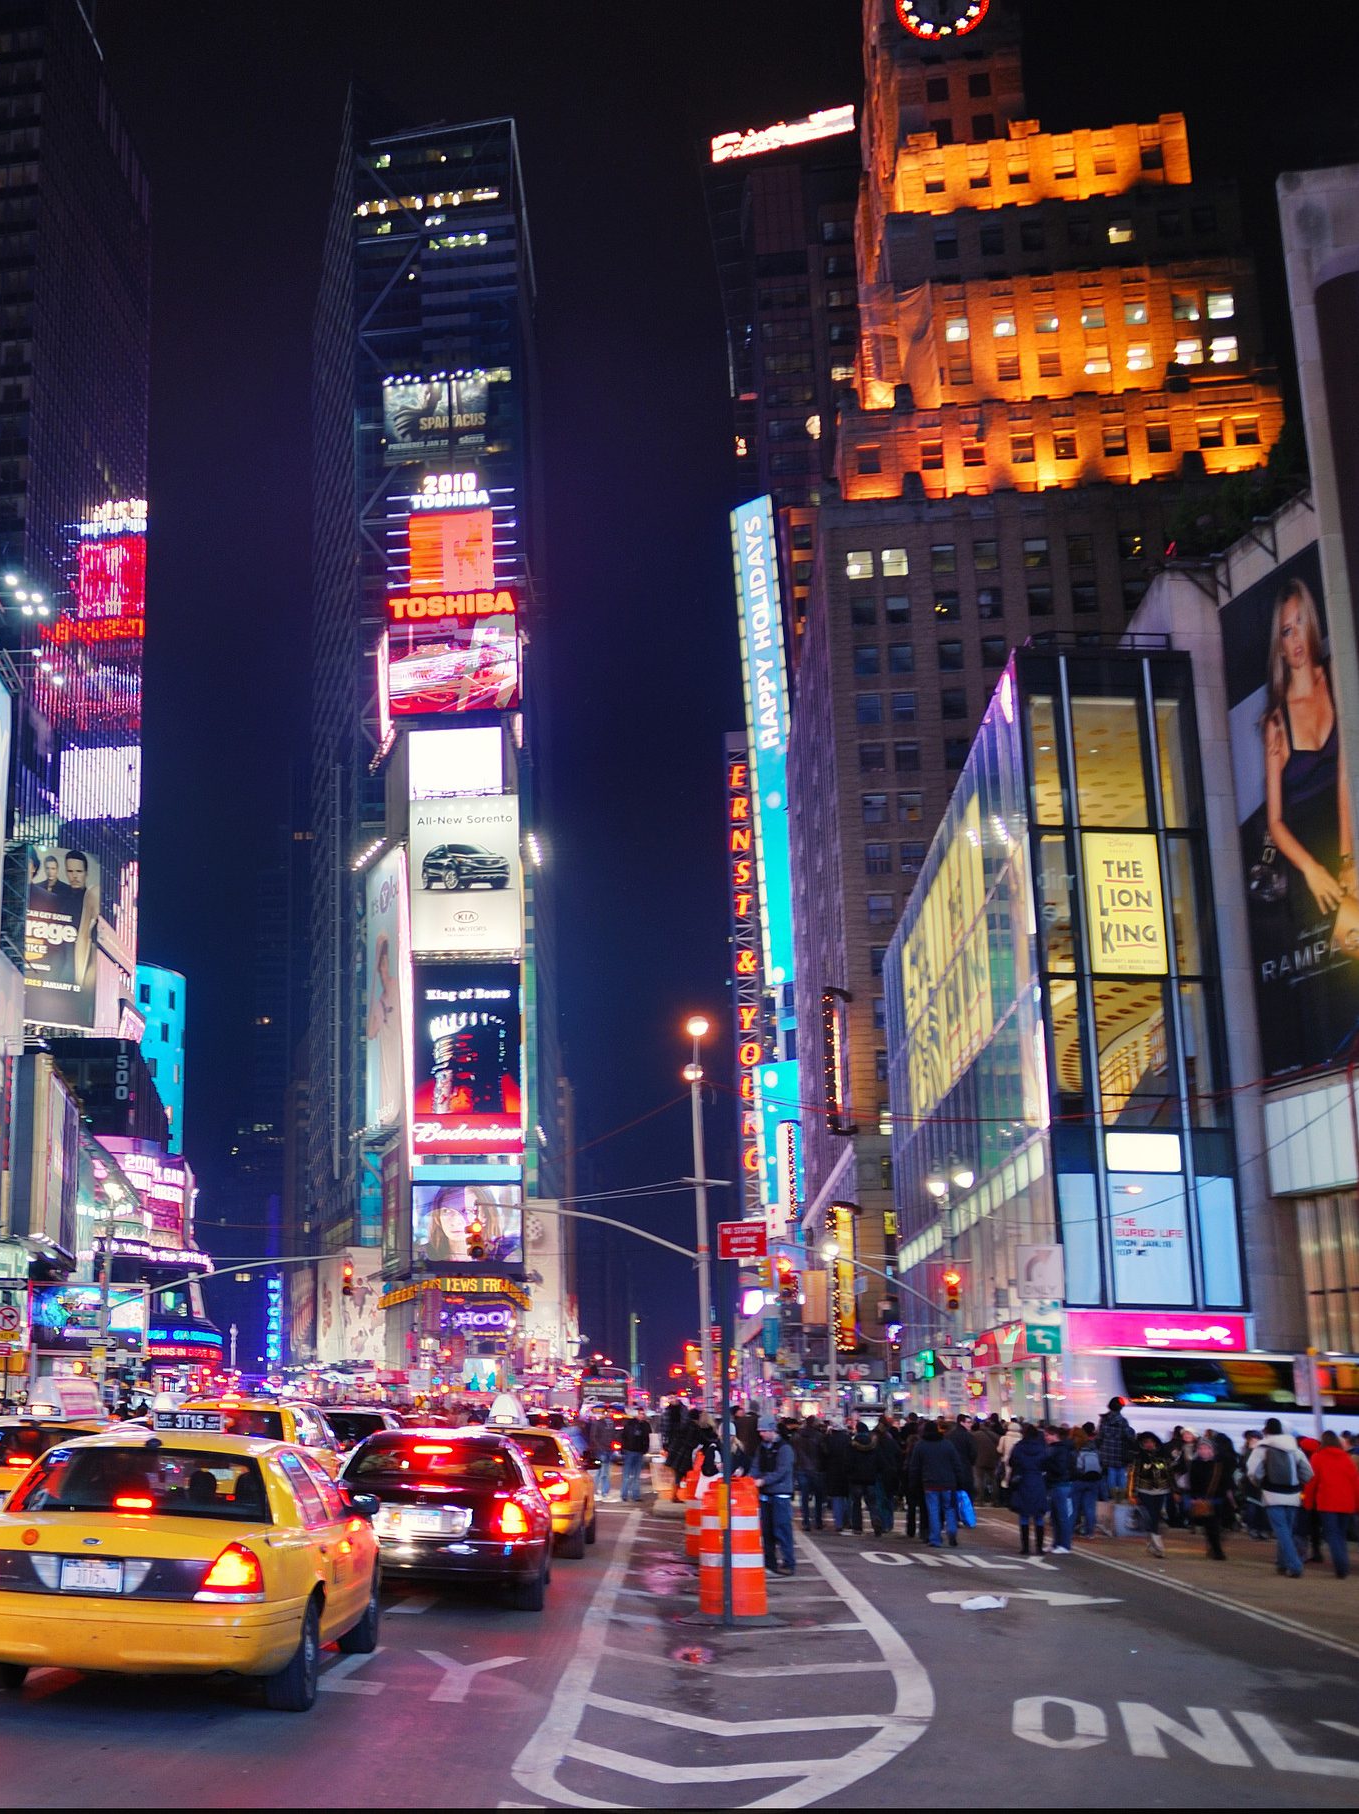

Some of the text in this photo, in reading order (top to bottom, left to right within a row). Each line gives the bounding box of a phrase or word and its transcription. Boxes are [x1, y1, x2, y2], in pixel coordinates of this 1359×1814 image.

[423, 472, 477, 495] 2010
[409, 490, 490, 510] TOSHIBA
[744, 515, 773, 652] HOLIDAYS
[389, 591, 515, 619] TOSHIBA
[756, 658, 781, 750] HAPPY
[417, 813, 513, 827] All-New Sorento
[729, 764, 753, 917] ERNST
[1103, 860, 1143, 878] THE
[1097, 884, 1153, 916] LION
[53, 912, 73, 922] SOME
[457, 913, 475, 921] KIA
[1099, 920, 1157, 954] KING
[736, 950, 759, 974] &
[42, 981, 72, 991] JANUARY
[73, 984, 81, 993] 12
[425, 988, 457, 1002] King
[458, 988, 473, 999] of
[114, 1039, 130, 1101] 1500
[412, 1122, 522, 1143] Budweiser
[1115, 1217, 1136, 1227] THE
[1115, 1228, 1185, 1238] BURIED LIFE
[1024, 1284, 1057, 1296] ONLY
[175, 1414, 205, 1429] 3T15
[860, 1550, 1060, 1571] ONLY
[1011, 1695, 1359, 1779] ONL
